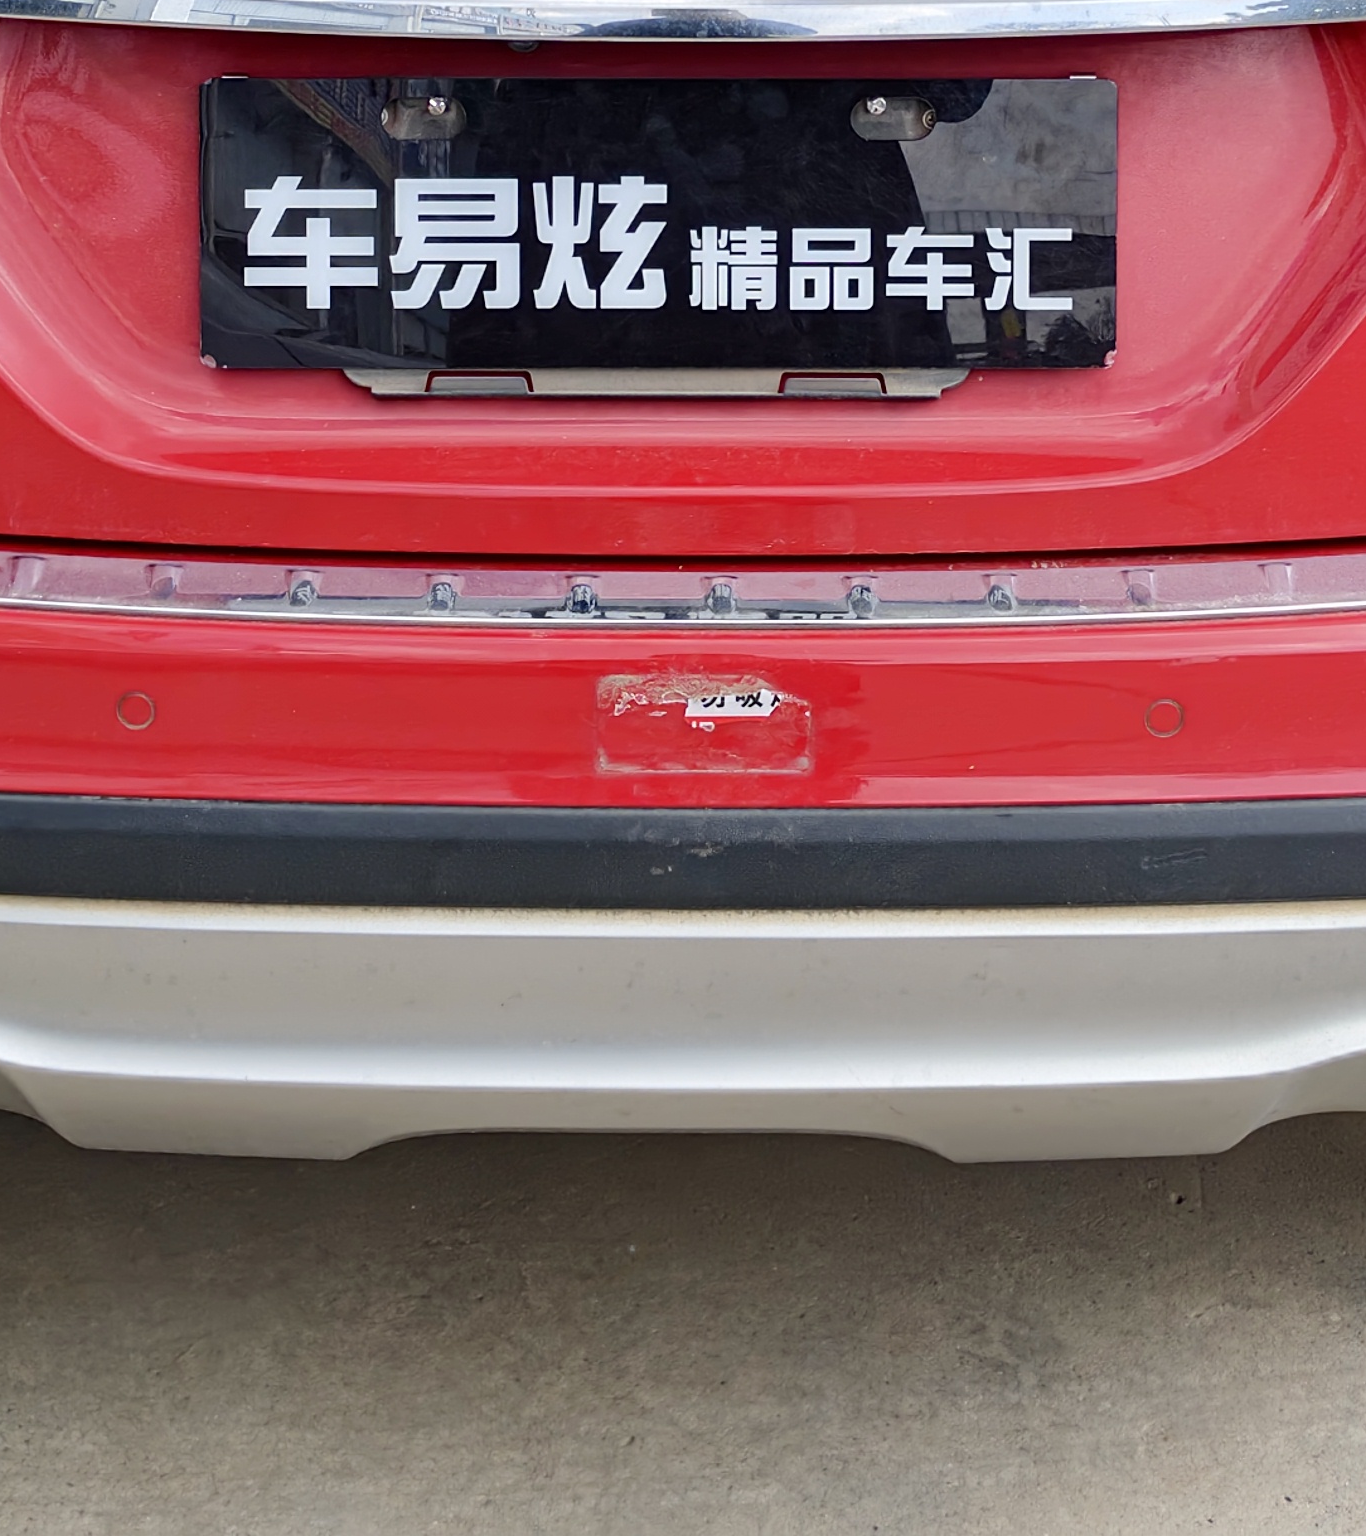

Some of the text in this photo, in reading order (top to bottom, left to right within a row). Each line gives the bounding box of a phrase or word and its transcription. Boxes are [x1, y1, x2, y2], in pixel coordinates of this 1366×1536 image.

[244, 176, 1073, 311] 车易炫 精品车汇
